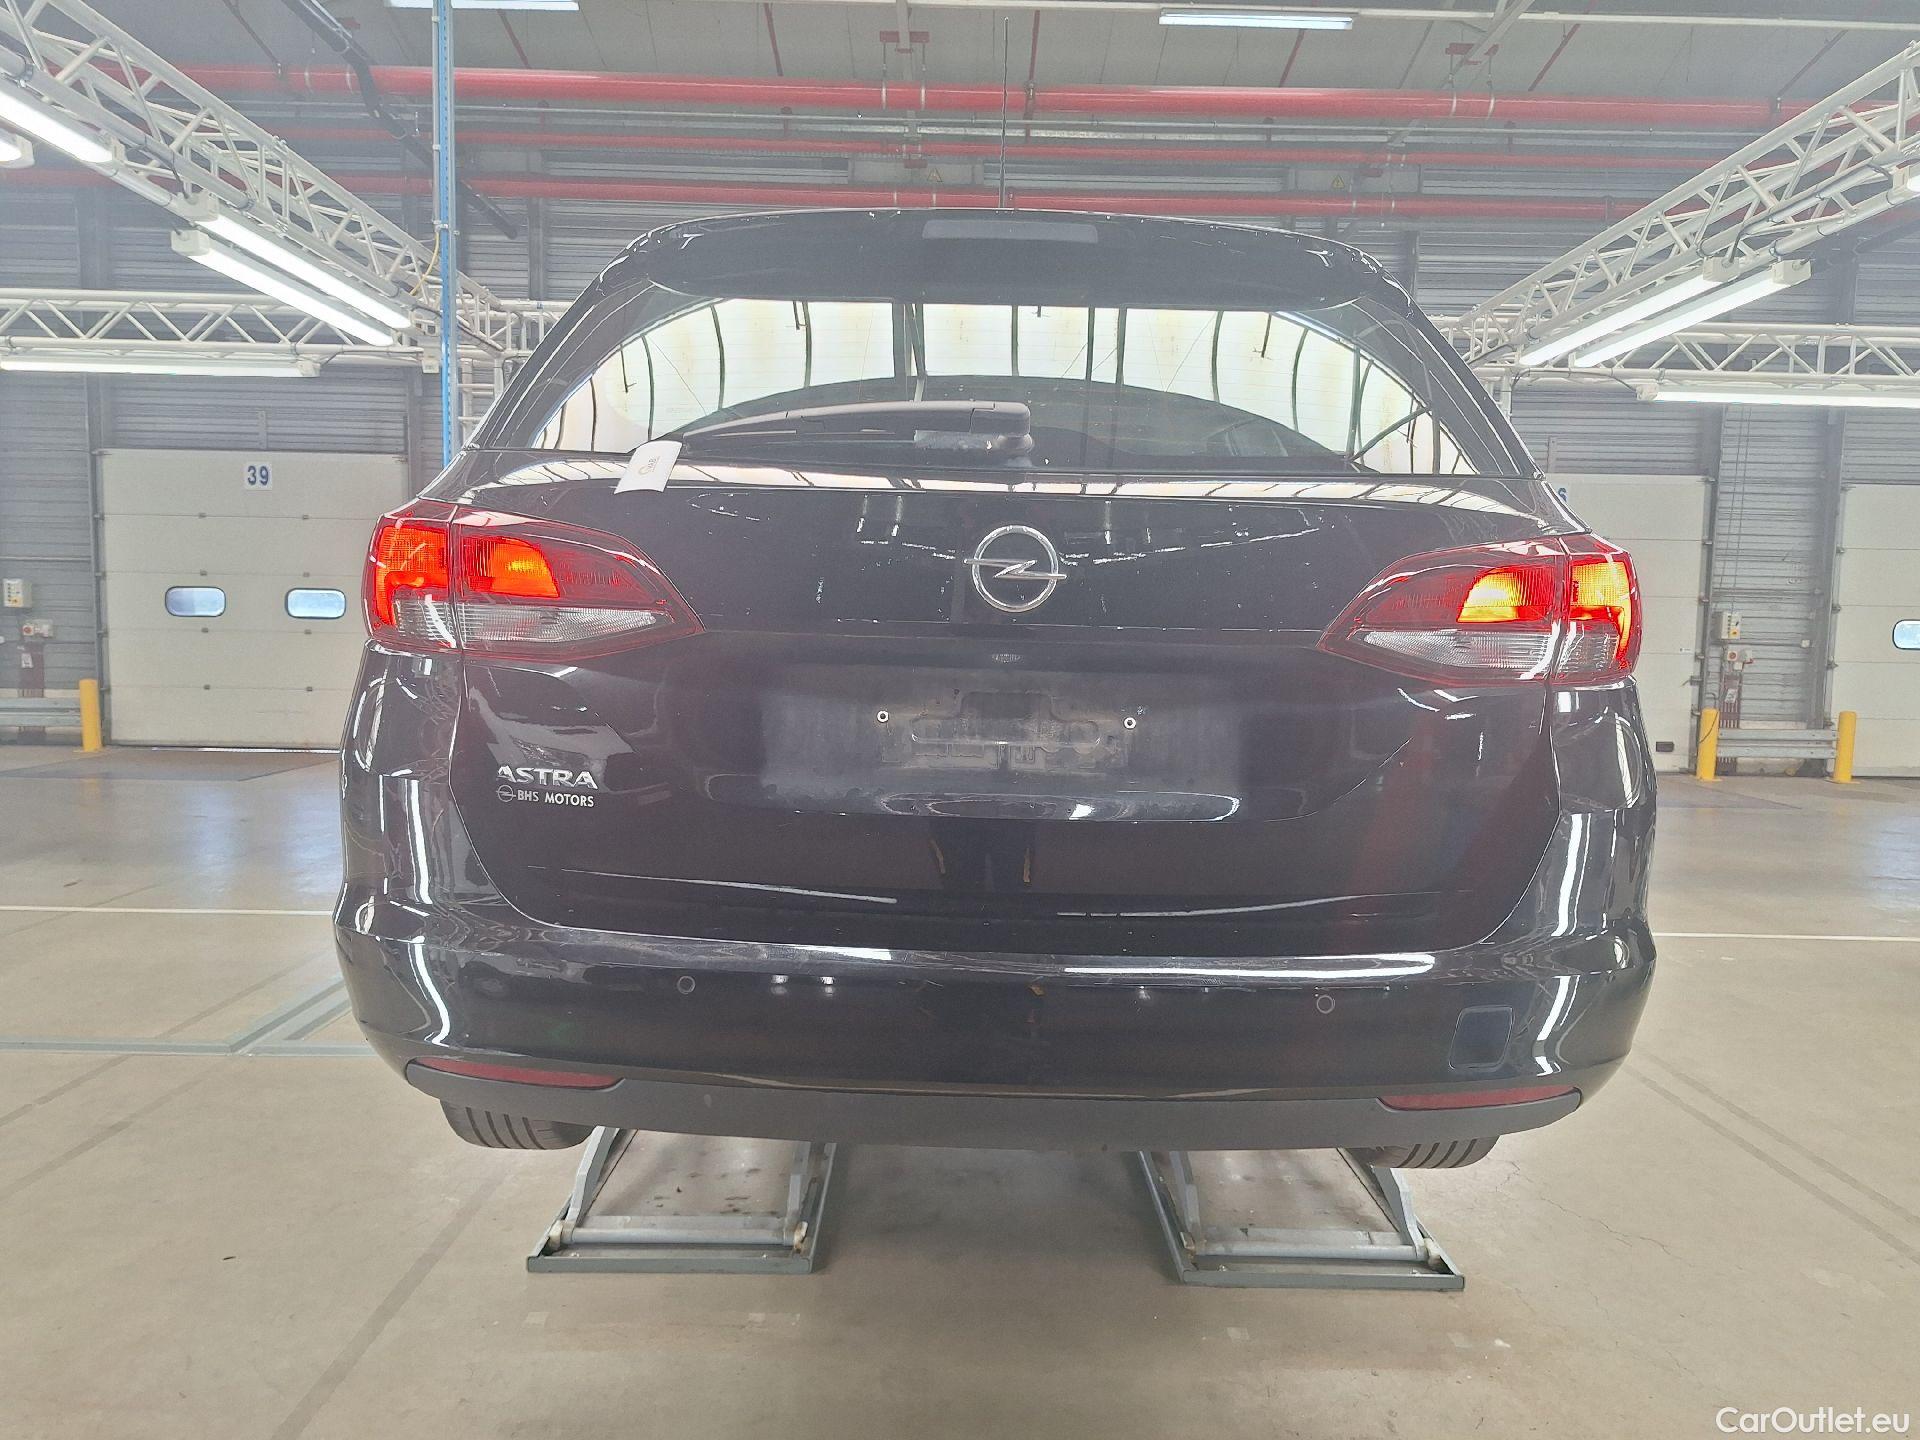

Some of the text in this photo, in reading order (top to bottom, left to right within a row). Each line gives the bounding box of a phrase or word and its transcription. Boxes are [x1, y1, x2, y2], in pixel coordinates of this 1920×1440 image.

[247, 465, 269, 486] 39
[497, 765, 599, 790] ASTRA
[517, 789, 595, 808] BHS MOTORS
